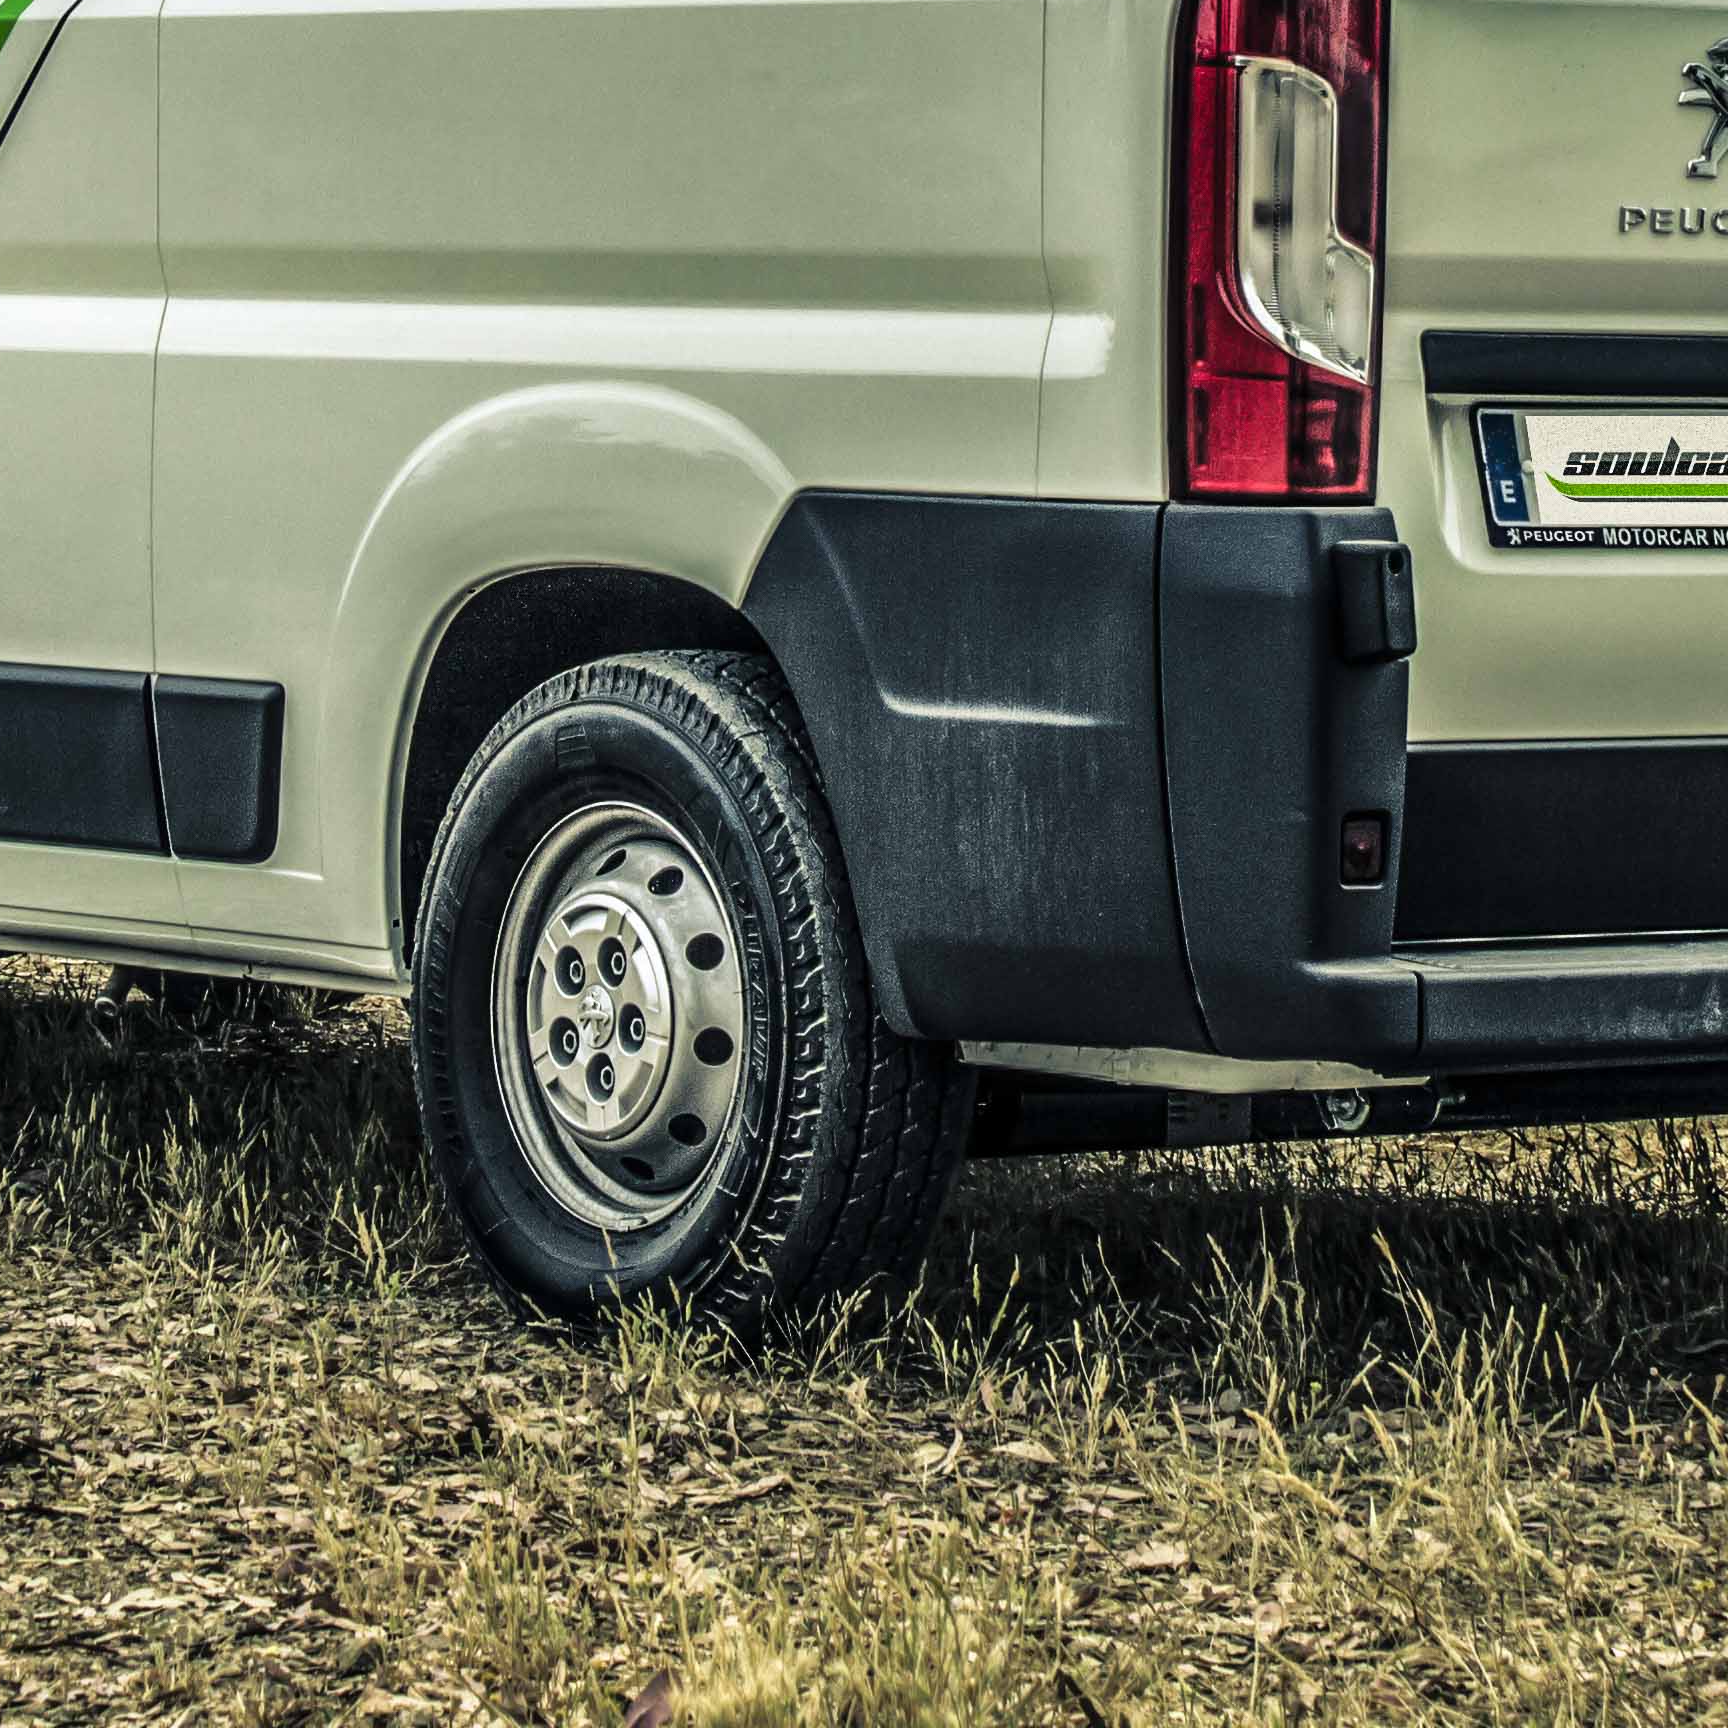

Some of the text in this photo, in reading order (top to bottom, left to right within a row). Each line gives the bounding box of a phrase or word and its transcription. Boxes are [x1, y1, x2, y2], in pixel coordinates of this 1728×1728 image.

[1500, 479, 1517, 504] E
[1523, 530, 1595, 542] PEUGEOT
[1602, 527, 1710, 546] MOTORCAR
